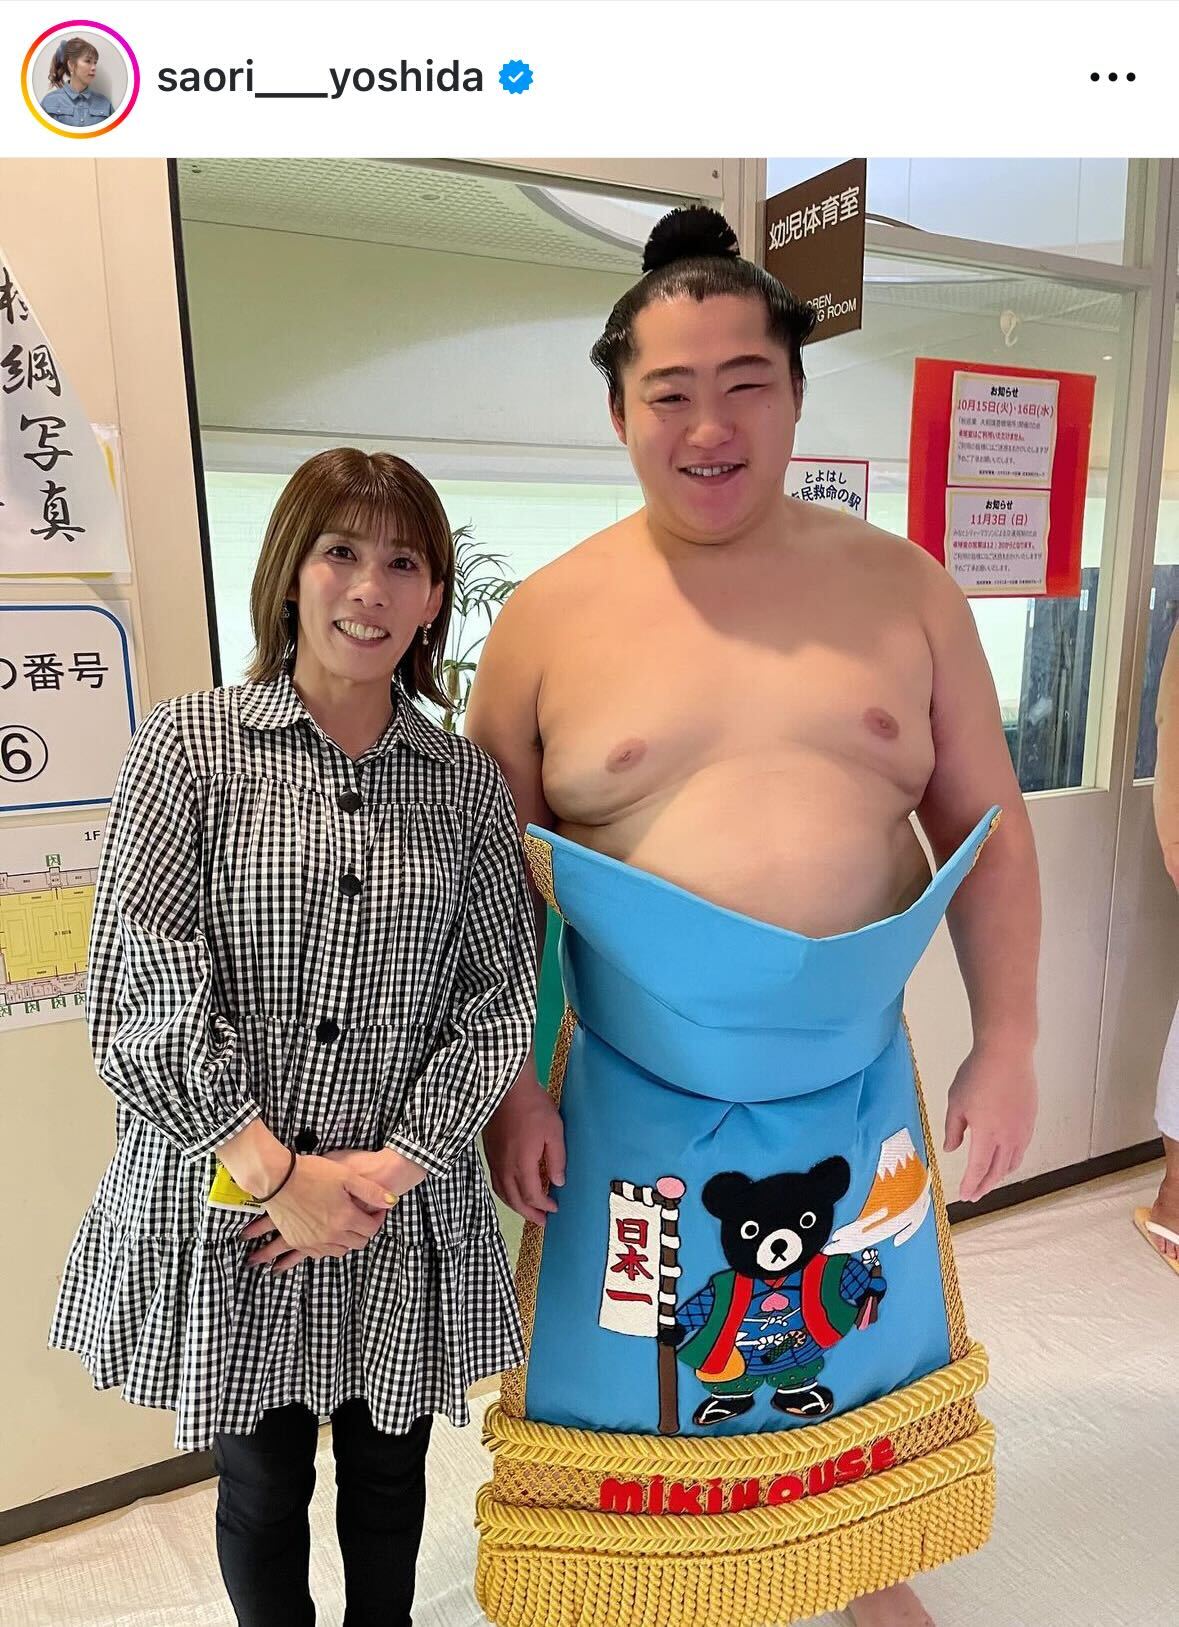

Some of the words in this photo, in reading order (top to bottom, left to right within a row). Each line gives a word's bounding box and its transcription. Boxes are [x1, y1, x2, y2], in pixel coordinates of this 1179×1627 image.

[769, 186, 860, 250] 幼児体育室
[827, 297, 857, 320] ROOM
[990, 386, 1019, 398] お知らせ
[804, 469, 847, 485] とよはし
[985, 499, 1014, 510] お知らせ
[84, 830, 101, 842] 1F
[604, 1217, 654, 1307] 日本一
